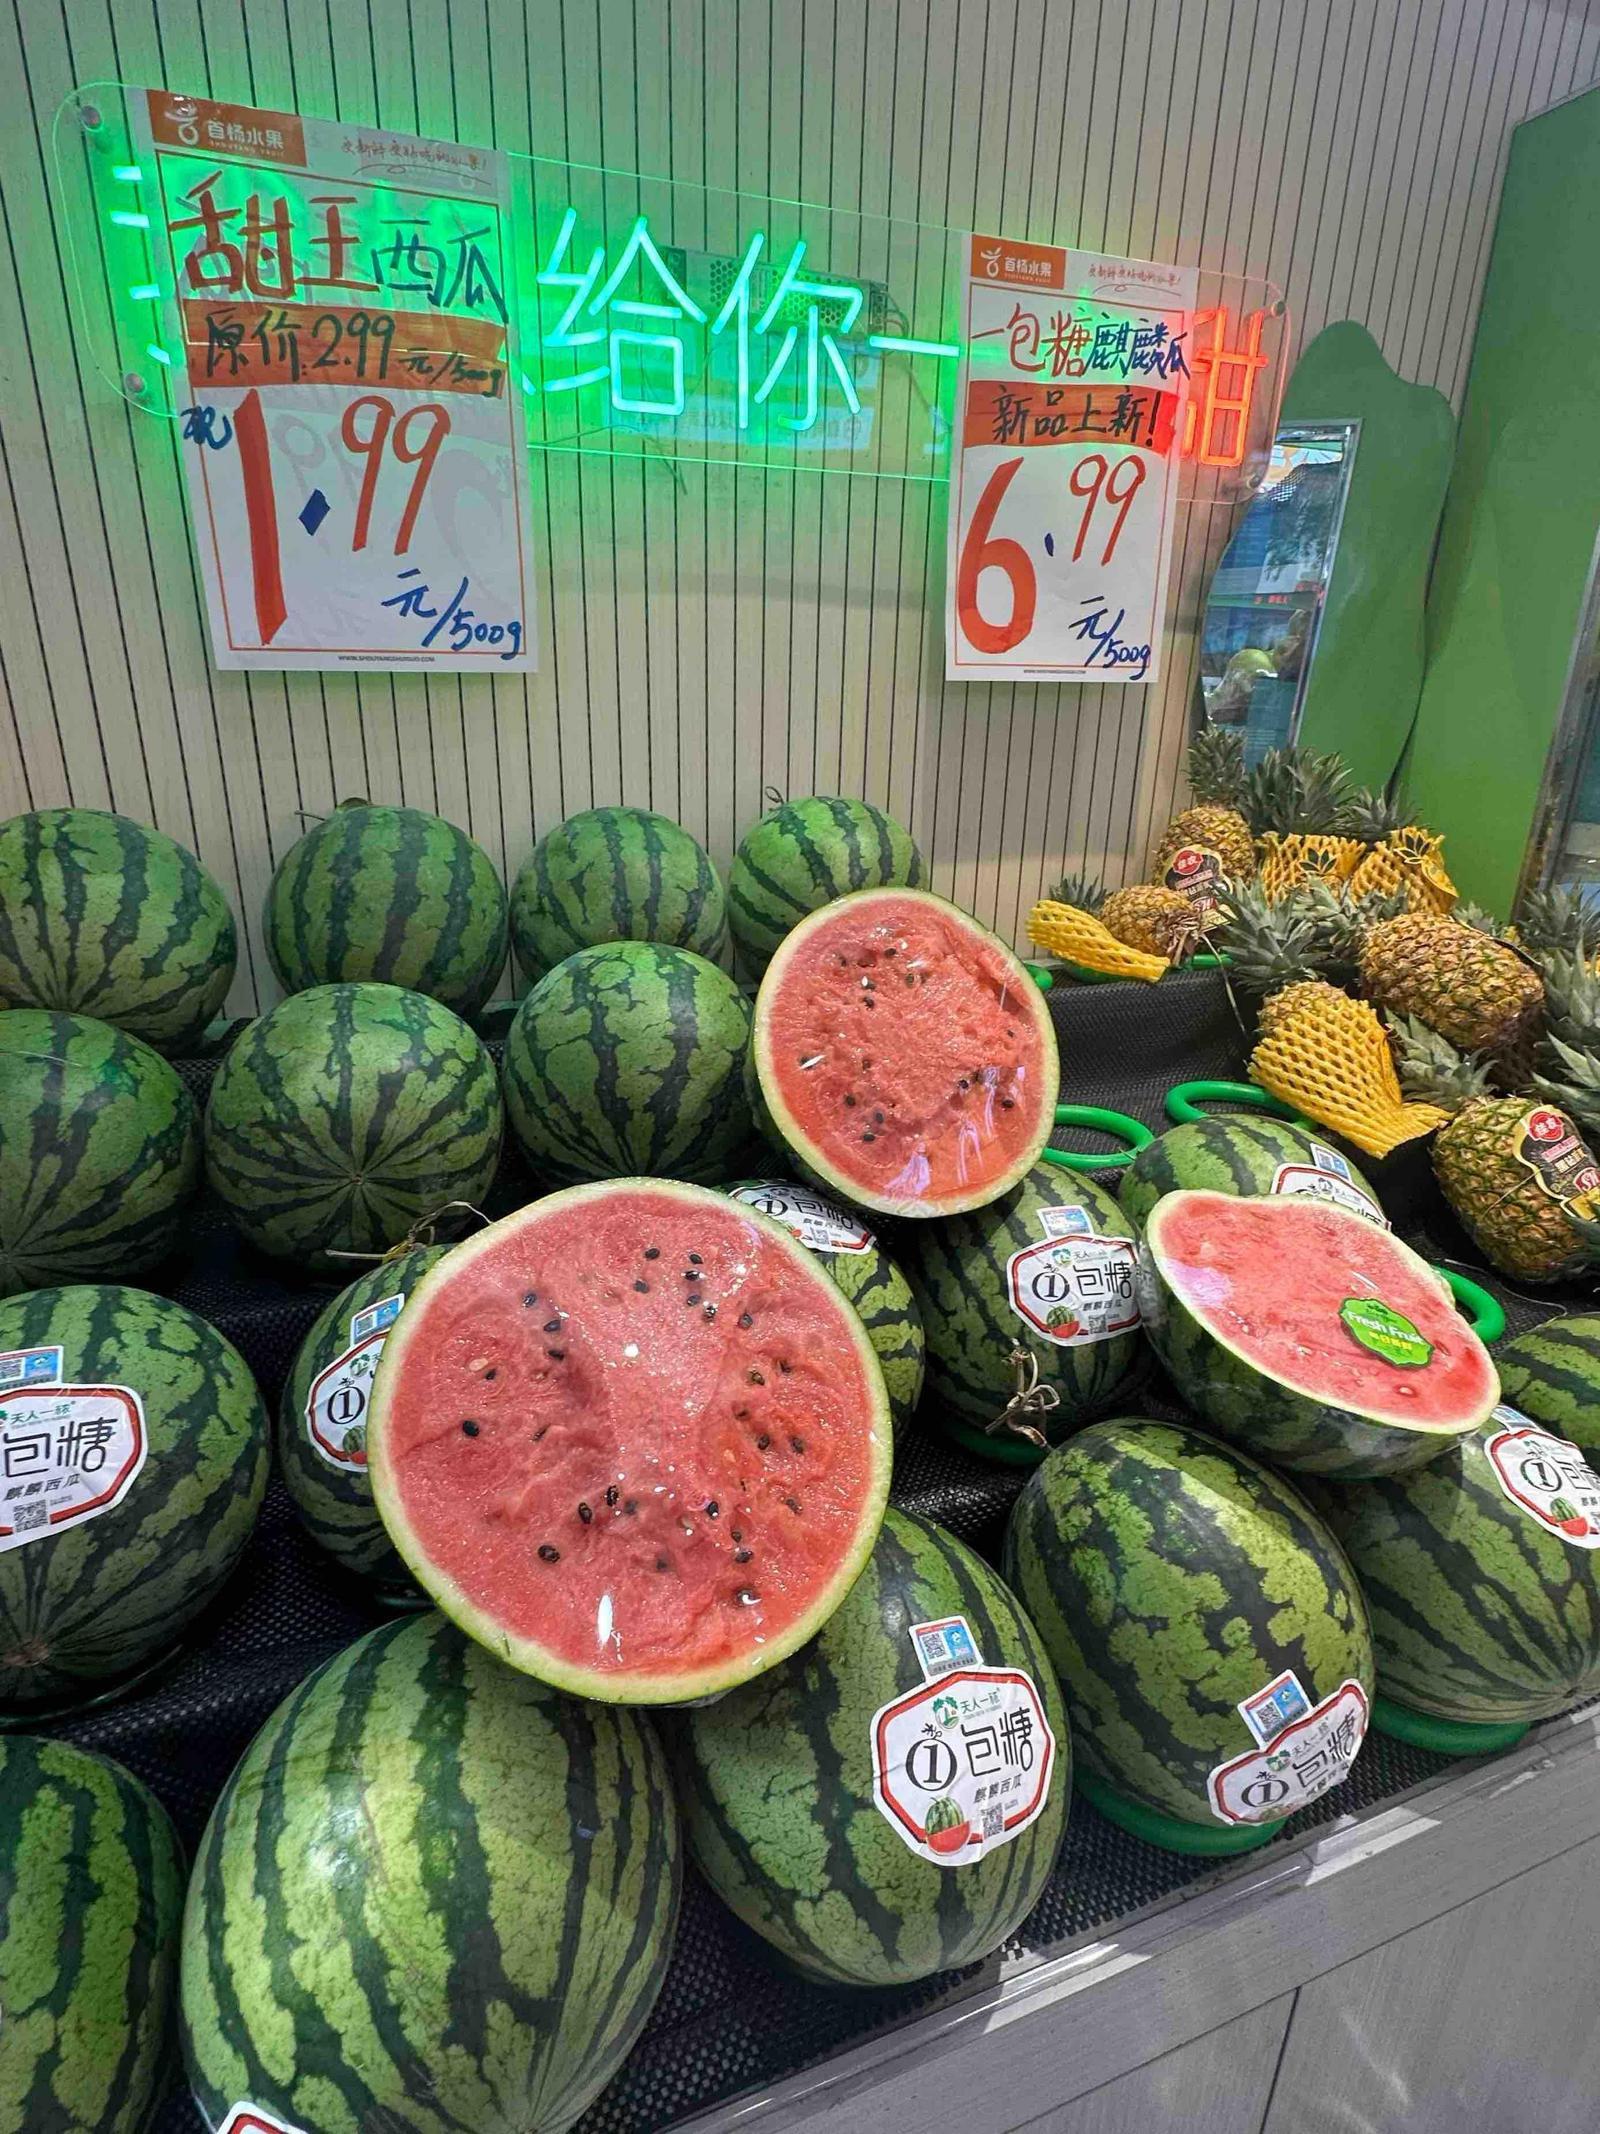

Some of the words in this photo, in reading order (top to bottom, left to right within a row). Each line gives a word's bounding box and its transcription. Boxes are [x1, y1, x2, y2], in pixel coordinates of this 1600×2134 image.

[207, 118, 285, 150] 首杨水果
[170, 170, 509, 323] 甜王西瓜
[1005, 256, 1052, 277] 首杨水果
[957, 454, 1147, 655] 6.99
[974, 1774, 1022, 1803] 麒麟西瓜
